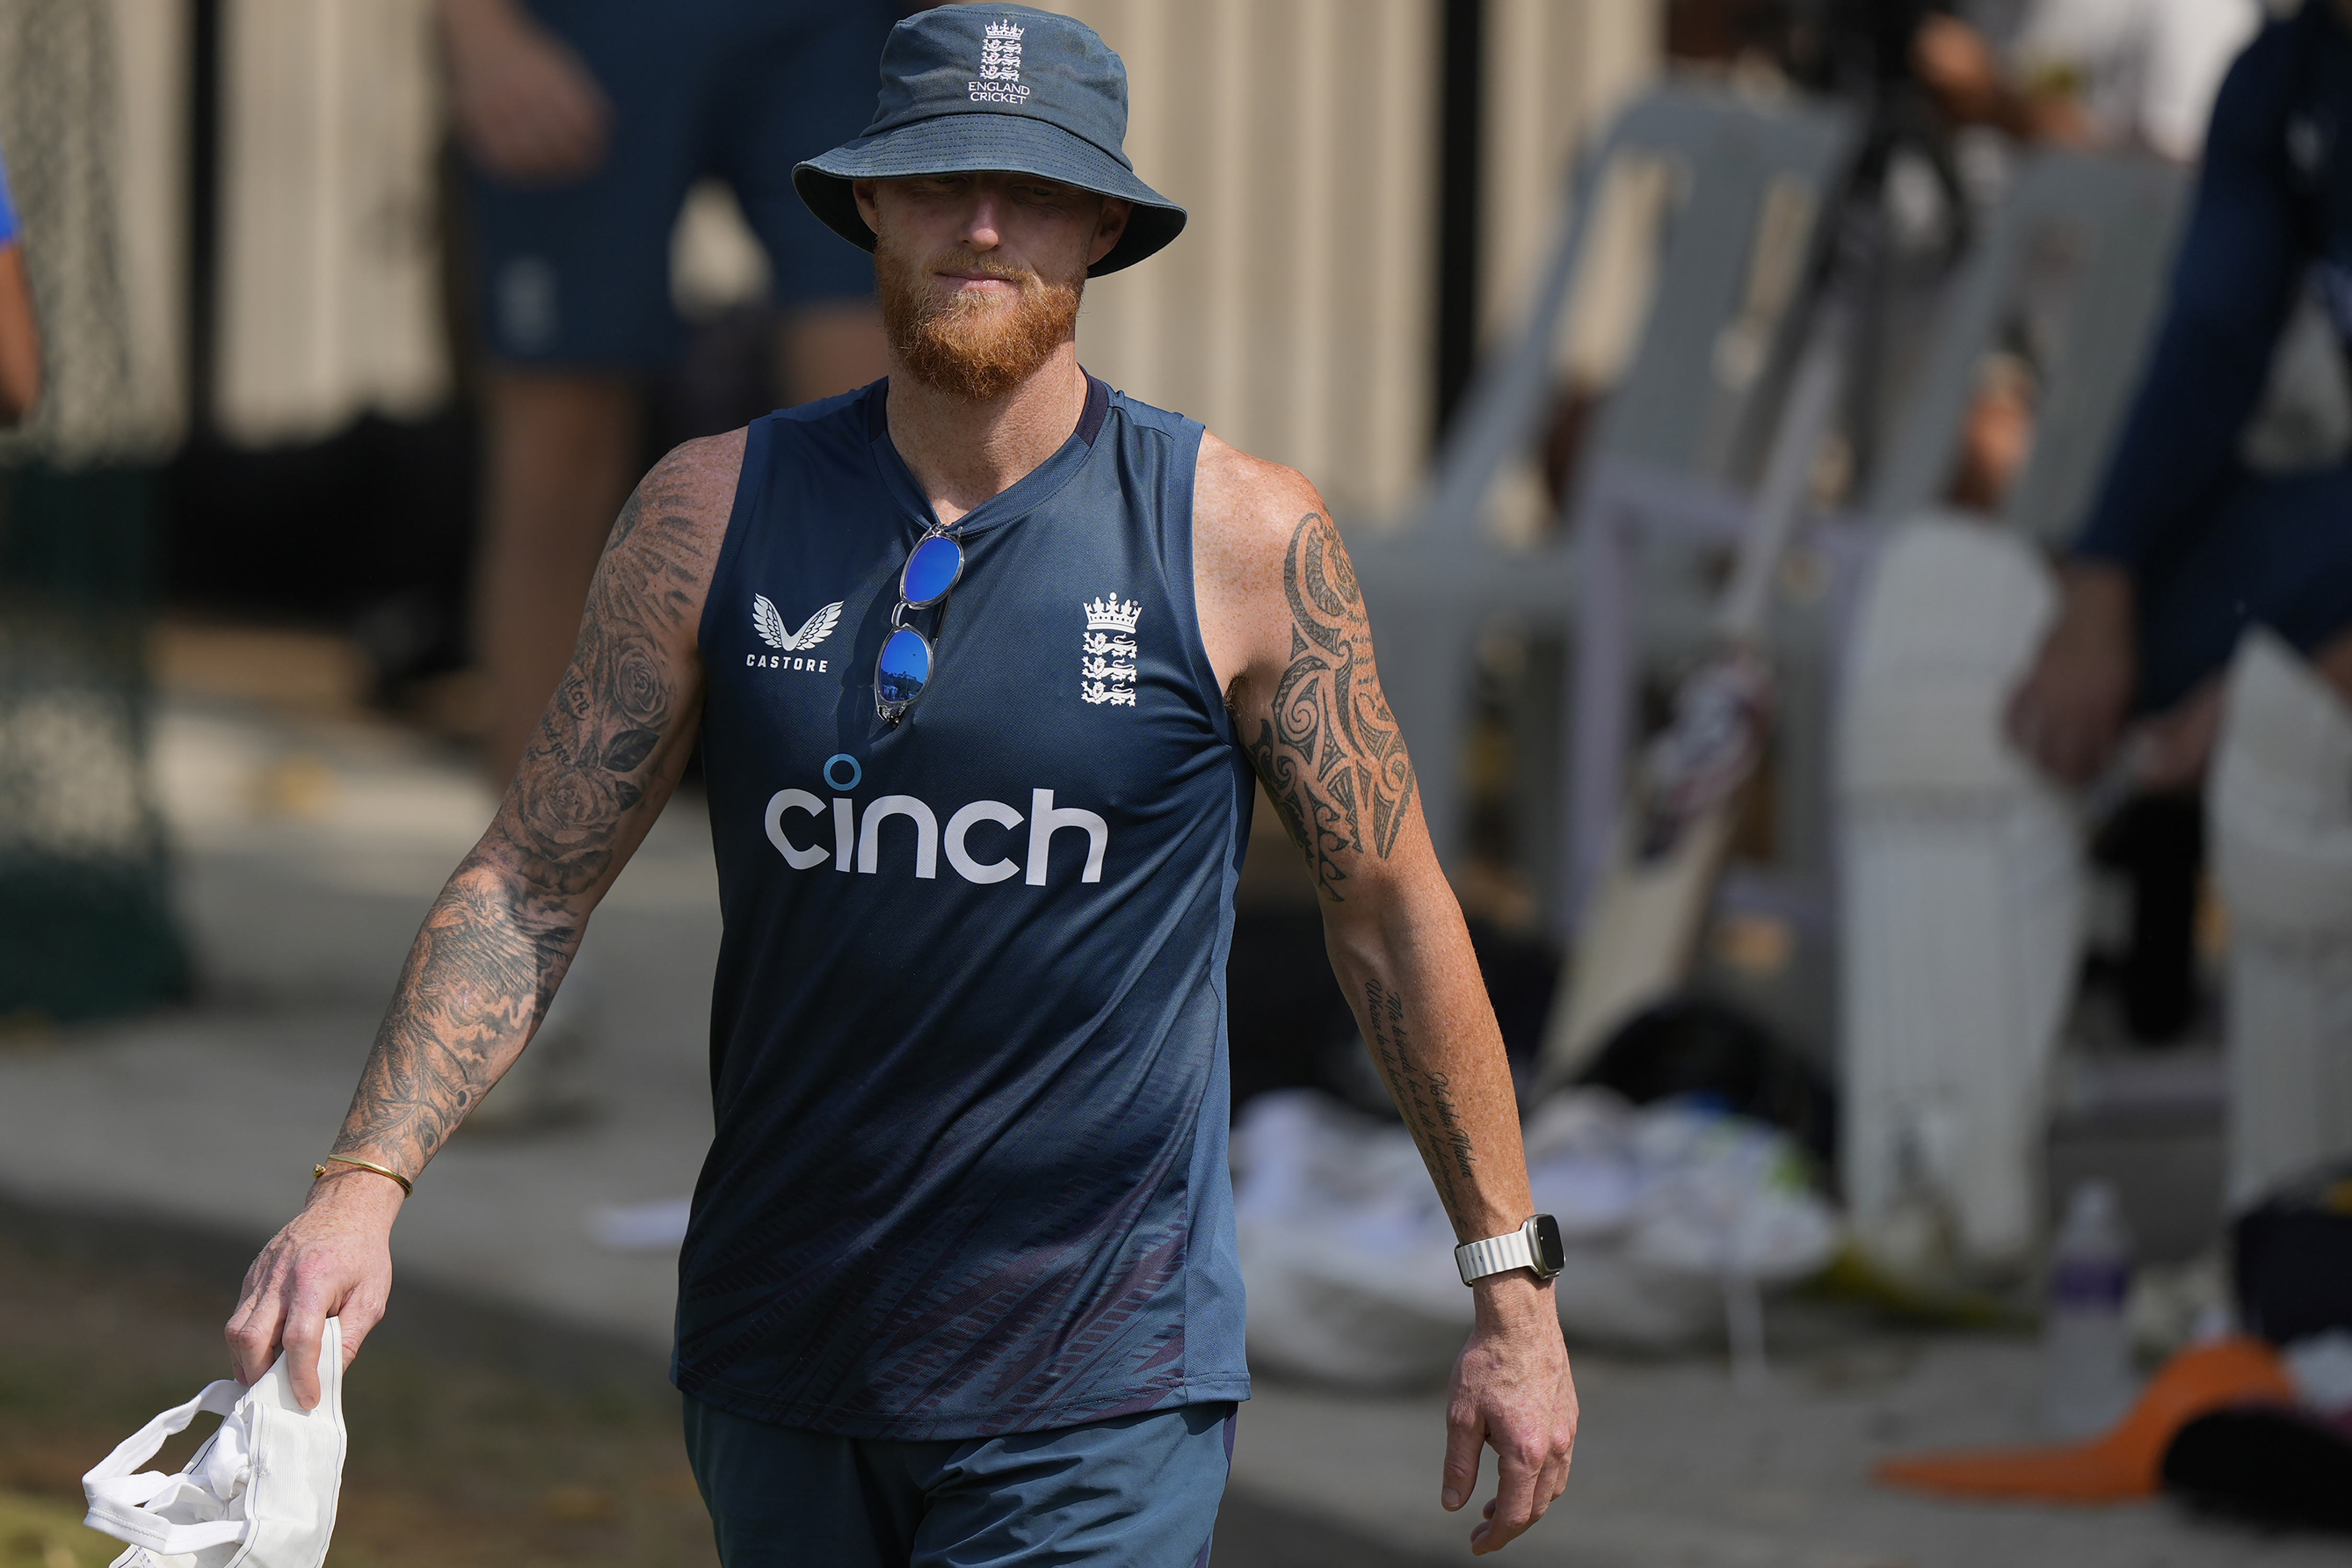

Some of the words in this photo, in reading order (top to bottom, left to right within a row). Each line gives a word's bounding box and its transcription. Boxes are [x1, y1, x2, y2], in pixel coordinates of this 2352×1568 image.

[968, 82, 1030, 96] ENGLAND
[970, 92, 1027, 105] CRICKET
[746, 654, 828, 673] CASTORE
[765, 753, 1109, 886] cinch
